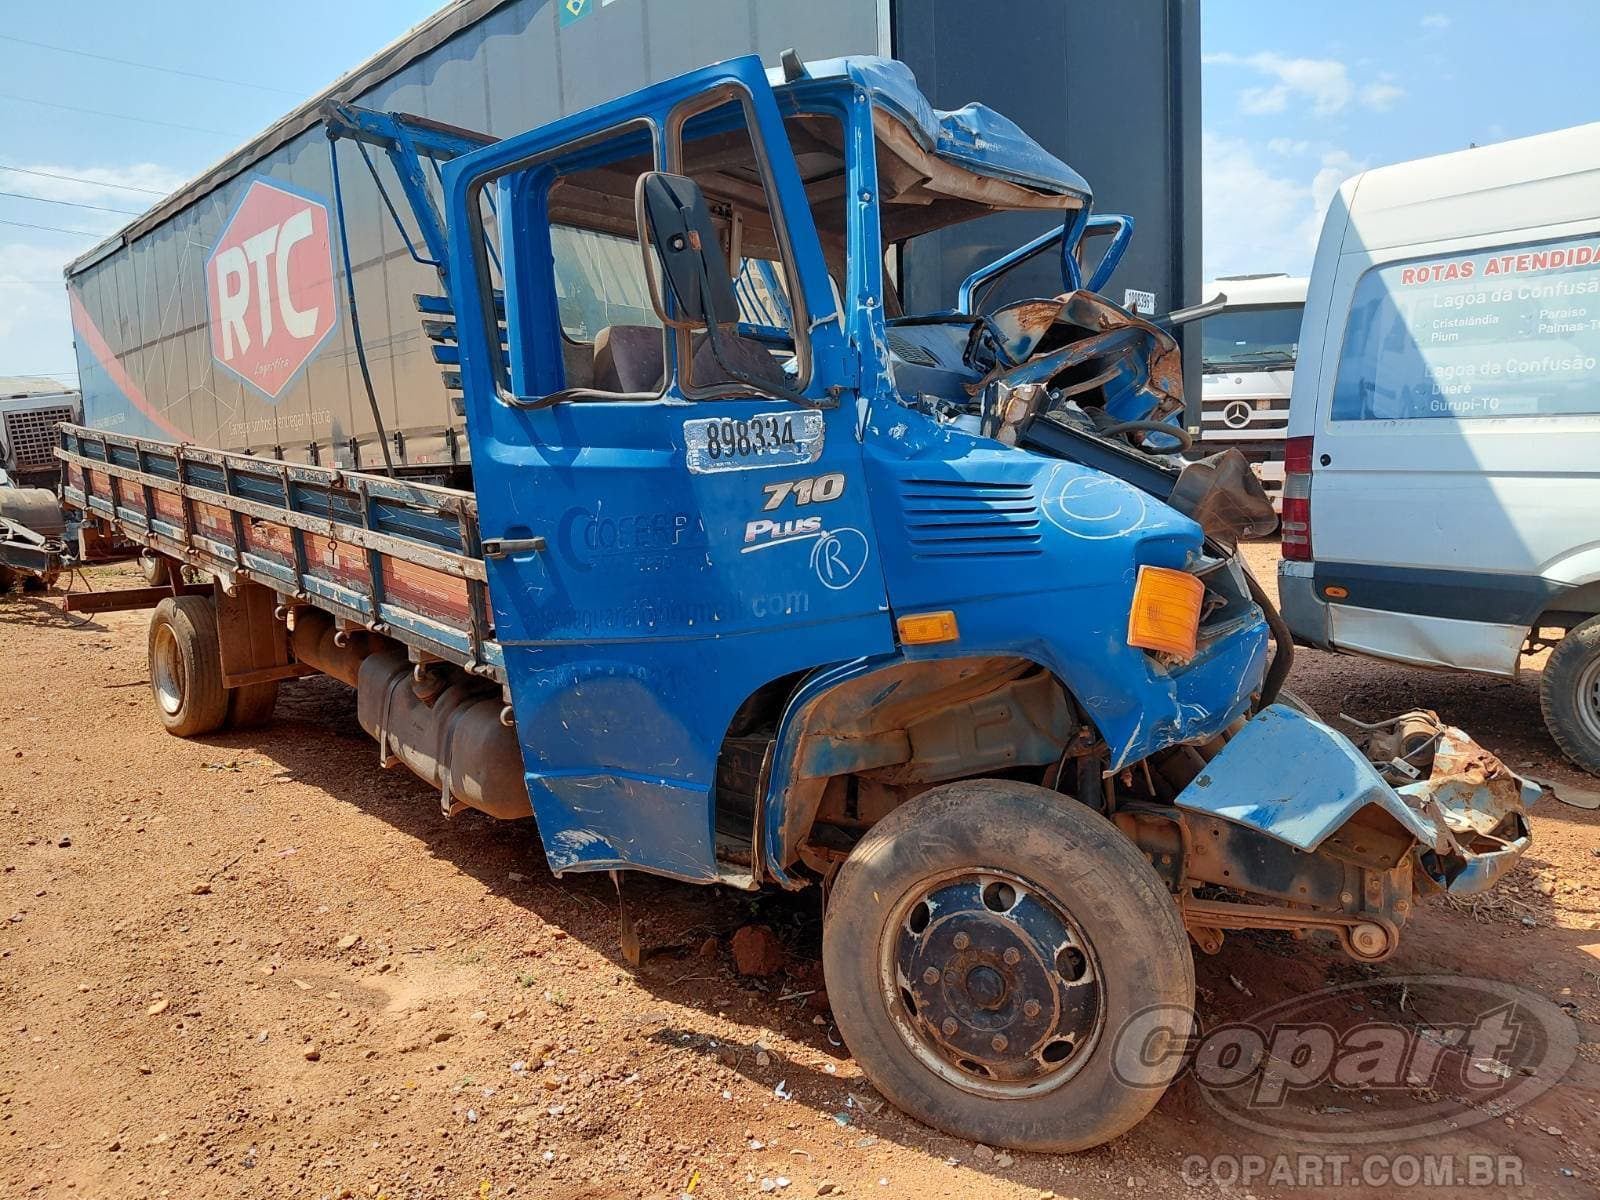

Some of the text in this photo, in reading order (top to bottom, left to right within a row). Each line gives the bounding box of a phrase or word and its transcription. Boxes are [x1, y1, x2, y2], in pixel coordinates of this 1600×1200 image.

[216, 207, 319, 361] RTC
[1402, 261, 1474, 285] ROTAS
[1433, 293, 1487, 309] Lagoa
[1491, 288, 1513, 302] da
[1431, 331, 1458, 343] Pium
[1425, 354, 1597, 380] Lagoa da Confusão
[706, 415, 796, 460] 898334
[762, 472, 846, 512] 710
